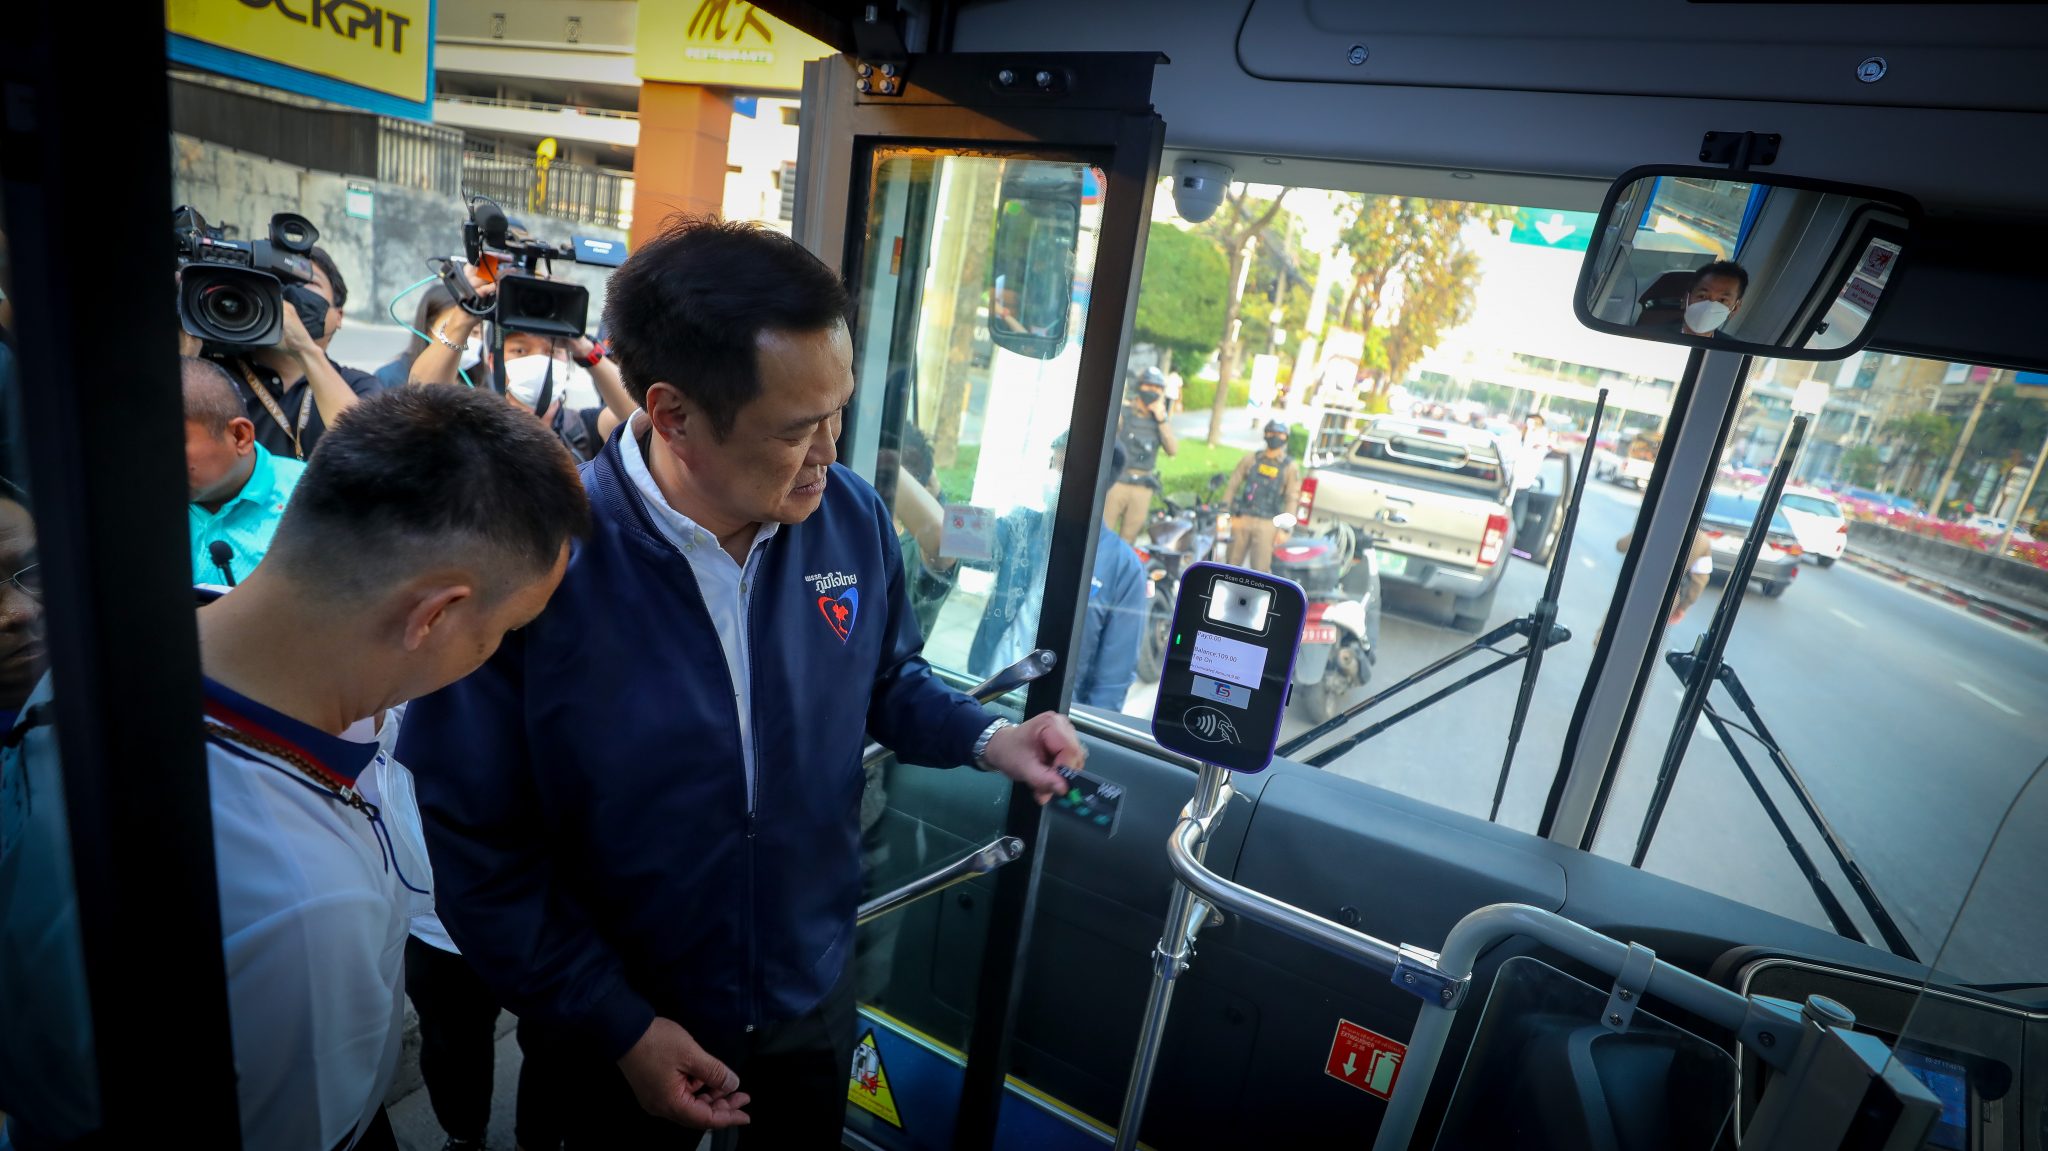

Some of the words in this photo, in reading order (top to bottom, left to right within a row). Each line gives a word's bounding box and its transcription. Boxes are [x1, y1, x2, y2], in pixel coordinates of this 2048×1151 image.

[815, 571, 857, 594] ภูมิใจไทย
[1224, 574, 1239, 582] Scan
[1250, 579, 1265, 588] Code
[1192, 653, 1203, 662] Tap
